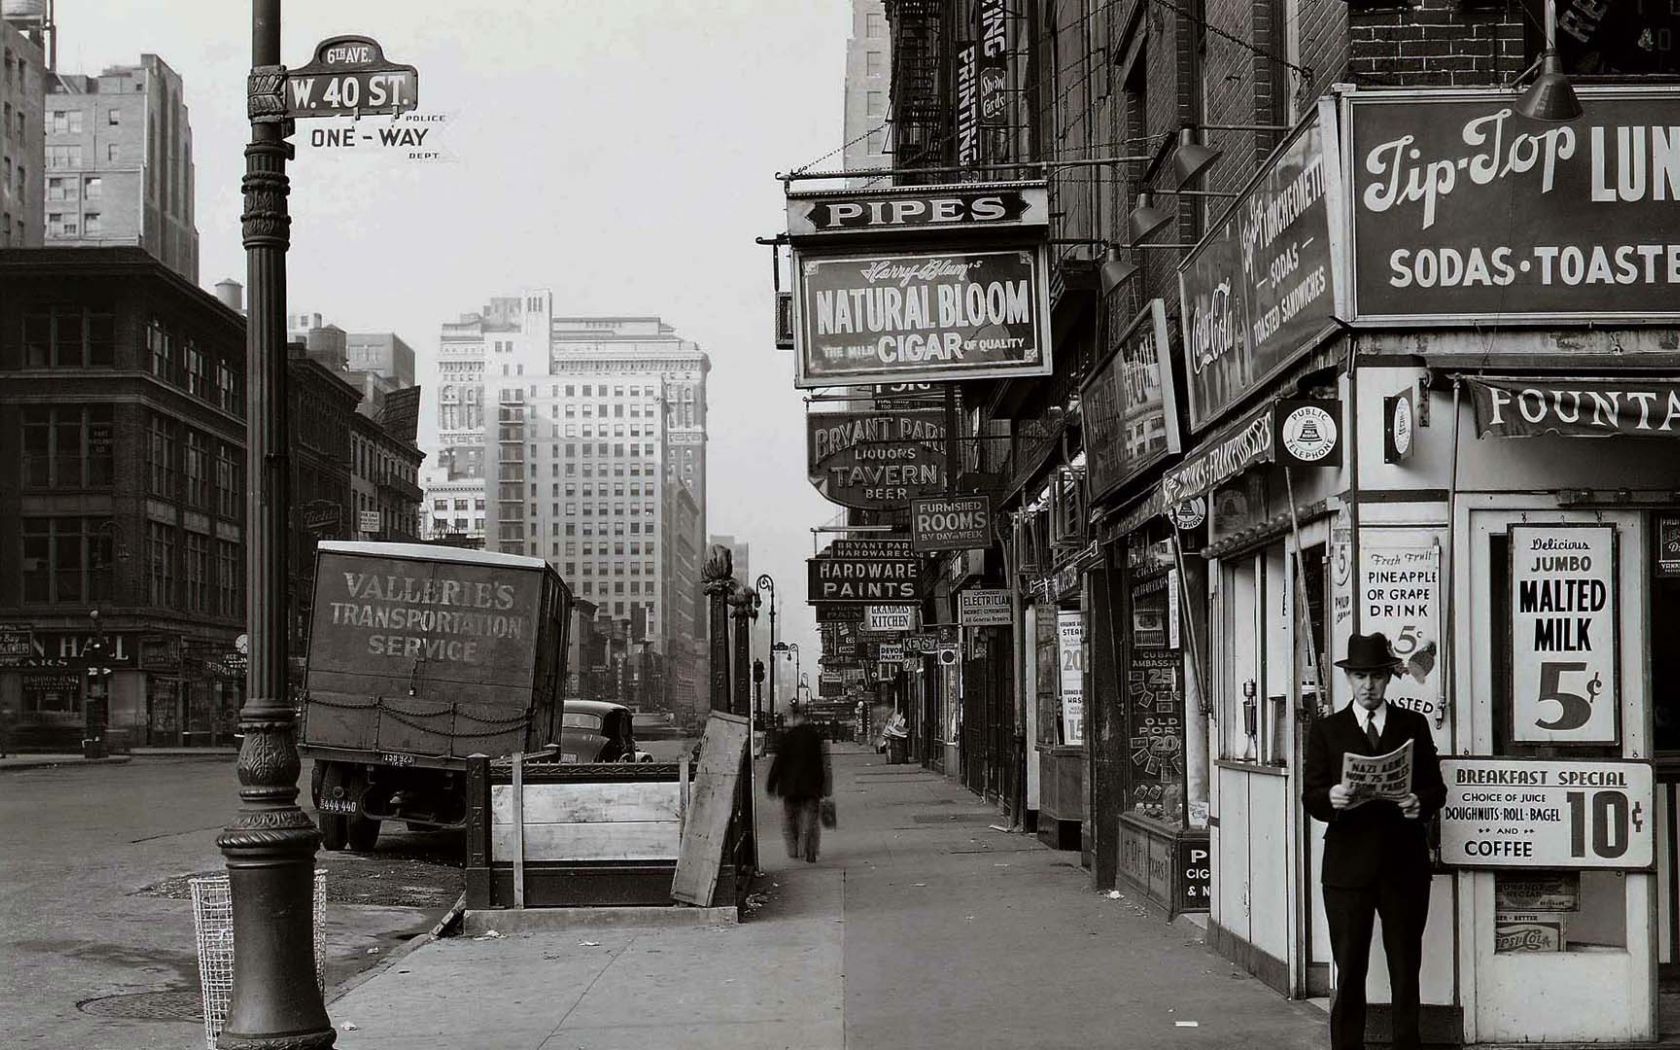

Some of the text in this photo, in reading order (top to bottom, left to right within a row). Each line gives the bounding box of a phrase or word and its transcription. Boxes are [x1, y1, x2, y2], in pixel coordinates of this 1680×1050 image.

[327, 47, 372, 64] 6TH AVE.
[291, 75, 408, 109] W. 40 ST.
[958, 45, 977, 166] PRINTING
[405, 115, 447, 123] POLICE
[1363, 108, 1576, 230] Tip-Top
[826, 197, 1006, 228] PIPES
[1270, 242, 1299, 288] SODAS
[1389, 247, 1516, 288] SODAS
[860, 260, 921, 288] Harry
[816, 280, 1029, 335] NATURAL BLOOM
[1253, 265, 1326, 347] TOASTED SANDWICHES
[877, 332, 964, 364] CIGAR
[964, 340, 978, 351] OF
[979, 338, 1025, 351] QUALITY
[1291, 407, 1328, 422] PUBLIC
[815, 417, 894, 465] BRYANT
[1286, 438, 1335, 459] TELEPHONE
[855, 448, 916, 460] LIQUORS
[831, 464, 937, 488] TAVERN
[866, 488, 907, 500] BEER
[920, 502, 982, 513] FURNISHED
[917, 511, 987, 532] ROOMS
[921, 533, 935, 541] BY
[936, 532, 952, 540] DAY
[1529, 537, 1591, 552] Delicious
[837, 542, 883, 550] BRYANT
[1370, 551, 1432, 567] Fresh Fruit
[1531, 556, 1592, 573] JUMBO
[820, 563, 917, 578] HARDWARE
[1368, 572, 1437, 584] PINEAPPLE
[343, 572, 515, 611] VALLERIE'S
[823, 583, 915, 598] PAINTS
[1367, 588, 1430, 600] OR GRAPE
[1519, 579, 1607, 613] MALTED
[1370, 604, 1429, 617] DRINK
[330, 602, 522, 640] TRANSPORTATION
[871, 615, 909, 628] KITCHEN
[1534, 618, 1592, 652] MILK
[368, 634, 478, 663] SERVICE
[1390, 697, 1434, 715] ASTED
[1145, 717, 1178, 726] OLD
[1352, 763, 1377, 773] NAZI
[1371, 774, 1383, 782] 75
[1456, 769, 1627, 787] BREAKFAST SPECIAL
[1462, 793, 1547, 803] CHOICE OF JUICE
[1530, 807, 1562, 823] BAGEL
[1464, 840, 1533, 858] COFFEE
